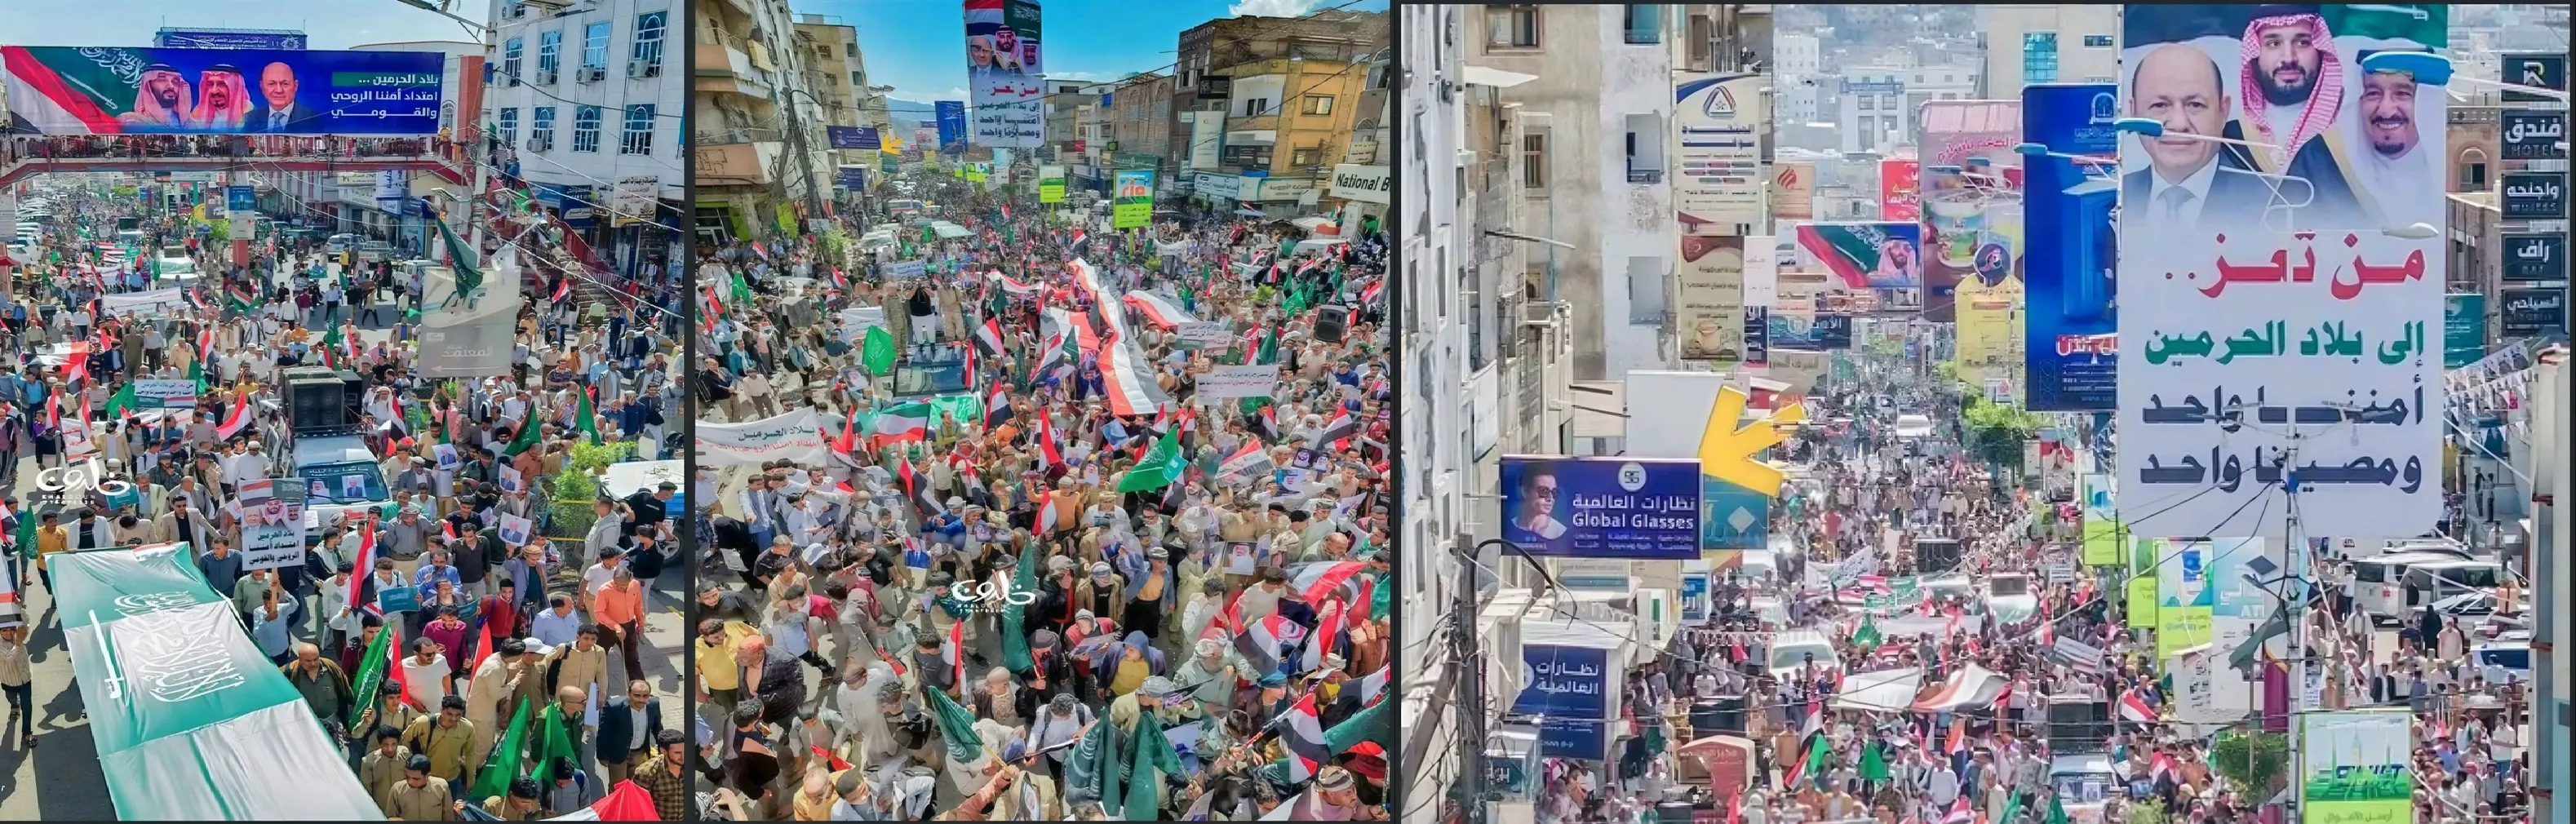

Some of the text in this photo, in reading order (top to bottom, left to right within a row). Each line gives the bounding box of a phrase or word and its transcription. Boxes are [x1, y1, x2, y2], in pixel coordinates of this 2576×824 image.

[373, 73, 416, 86] الحرمين
[418, 73, 439, 86] بلاد
[330, 88, 437, 103] امتداد أمننا الروحي
[1018, 82, 1040, 97] من
[979, 115, 1002, 126] واحد
[980, 127, 1003, 138] واحد
[2505, 117, 2562, 144] فندق
[1335, 172, 1381, 191] National
[2197, 229, 2317, 299] تعز
[2330, 232, 2427, 301] من
[2144, 319, 2286, 367] الحرمين
[2299, 319, 2363, 365] بلاد
[2377, 319, 2425, 369] إلى
[2141, 374, 2425, 434] أمننا واحد
[738, 425, 815, 441] بلاد الحرمين
[2140, 445, 2242, 494] واحد
[1572, 493, 1696, 514] نظارات العالمية
[1572, 512, 1695, 529] Global Glasses
[1535, 660, 1599, 676] نظارات
[1535, 677, 1599, 695] العالمية
